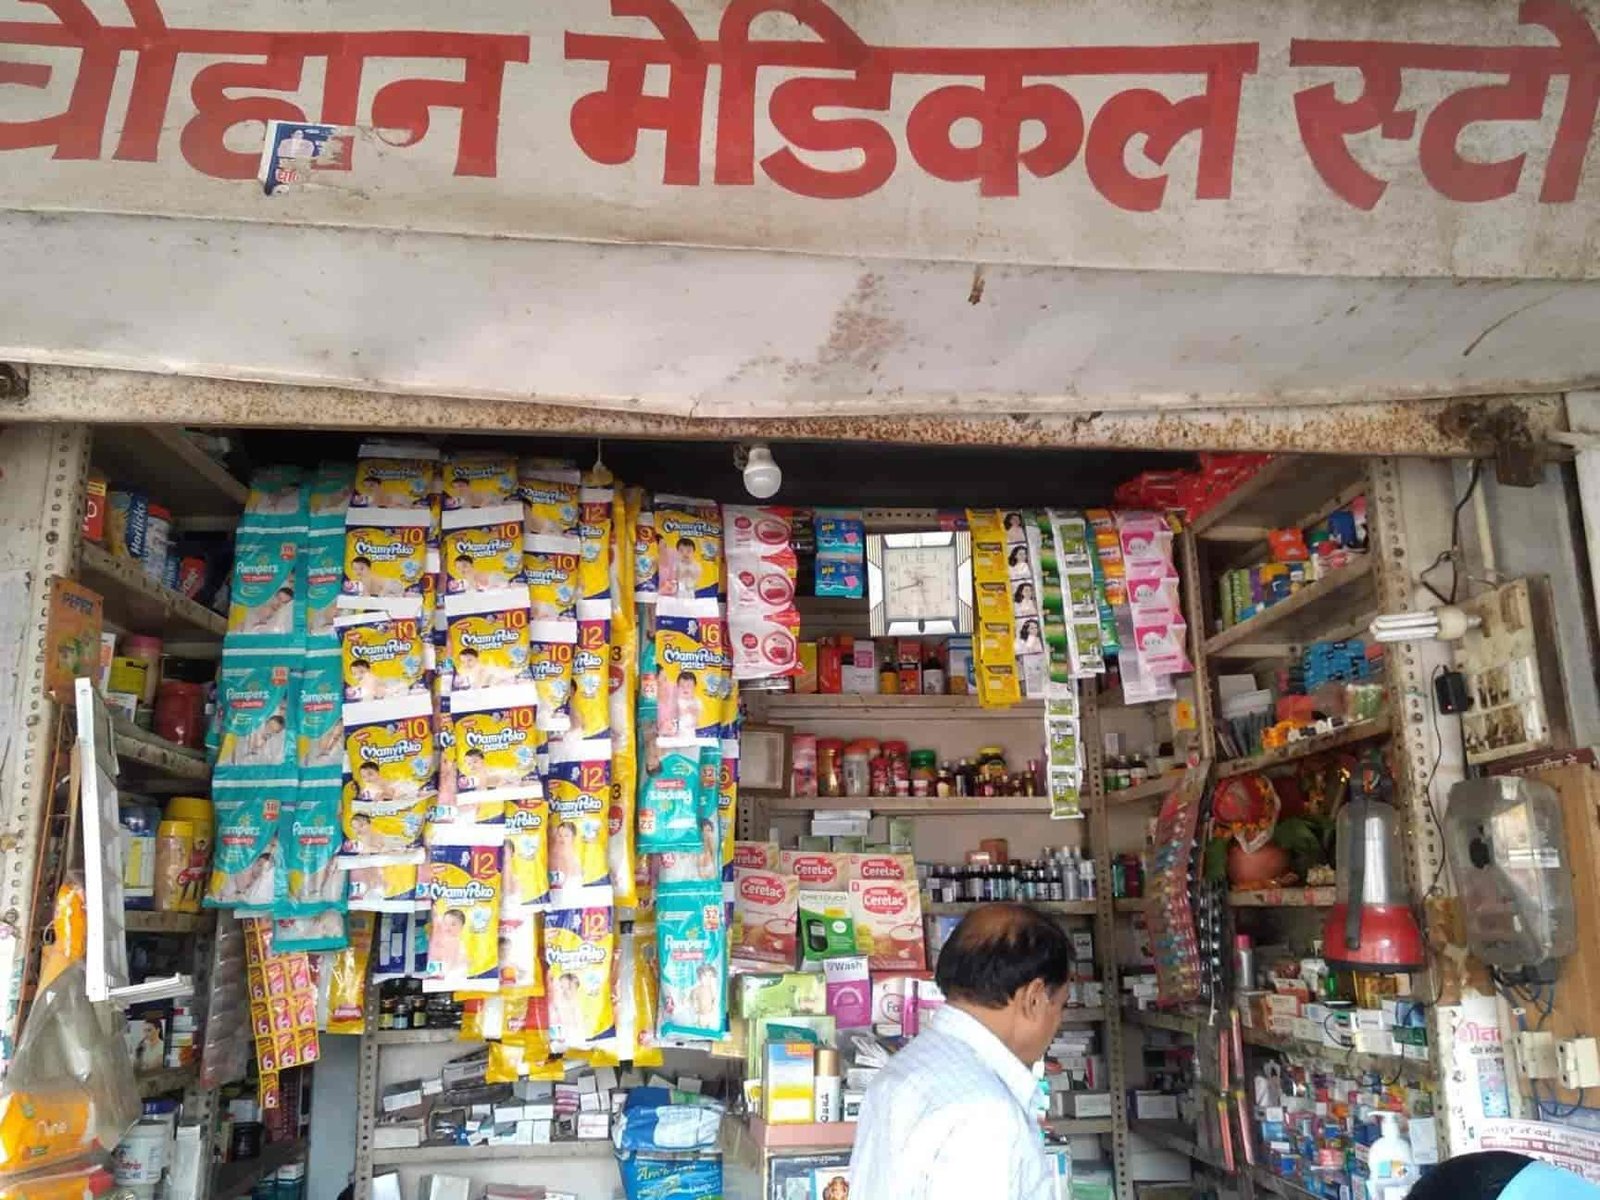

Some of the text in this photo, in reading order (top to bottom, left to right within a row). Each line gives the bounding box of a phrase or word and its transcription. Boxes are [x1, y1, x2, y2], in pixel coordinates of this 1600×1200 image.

[564, 0, 1260, 212] मेडिकल
[583, 506, 604, 521] 12
[130, 501, 147, 556] Horlicks
[402, 528, 423, 543] 10
[499, 524, 520, 538] 10
[664, 521, 720, 535] MamyPoko
[357, 543, 413, 557] MamyPoko
[456, 540, 513, 555] MamyPoko
[236, 561, 279, 574] Pampers
[556, 555, 576, 570] 10
[526, 569, 568, 582] amyPoko
[505, 610, 526, 628] 10
[397, 621, 416, 638] 10
[582, 626, 603, 646] 12
[700, 624, 720, 642] 16
[462, 630, 520, 646] MamyPoko
[352, 641, 411, 657] MamyPoko
[551, 645, 571, 662] 10
[612, 647, 622, 660] 3
[665, 646, 722, 663] MamyPoko
[226, 689, 269, 702] Pampers
[511, 708, 533, 728] 10
[407, 719, 428, 738] 10
[466, 730, 526, 746] MamyPoko
[360, 741, 421, 760] MamyPoko
[581, 764, 604, 788] 12
[611, 783, 622, 799] 3
[549, 792, 602, 813] MamyPoko
[291, 822, 335, 837] Pampers
[505, 814, 541, 831] yPoko
[471, 852, 496, 875] 12
[735, 853, 765, 865] relac
[794, 864, 834, 876] Cerelac
[862, 867, 902, 878] Cerelac
[431, 882, 495, 900] MamyPoko
[741, 881, 783, 898] Cerelac
[863, 895, 905, 907] Cerelac
[704, 906, 718, 920] 32
[585, 913, 609, 935] 12
[664, 934, 710, 950] Pampers
